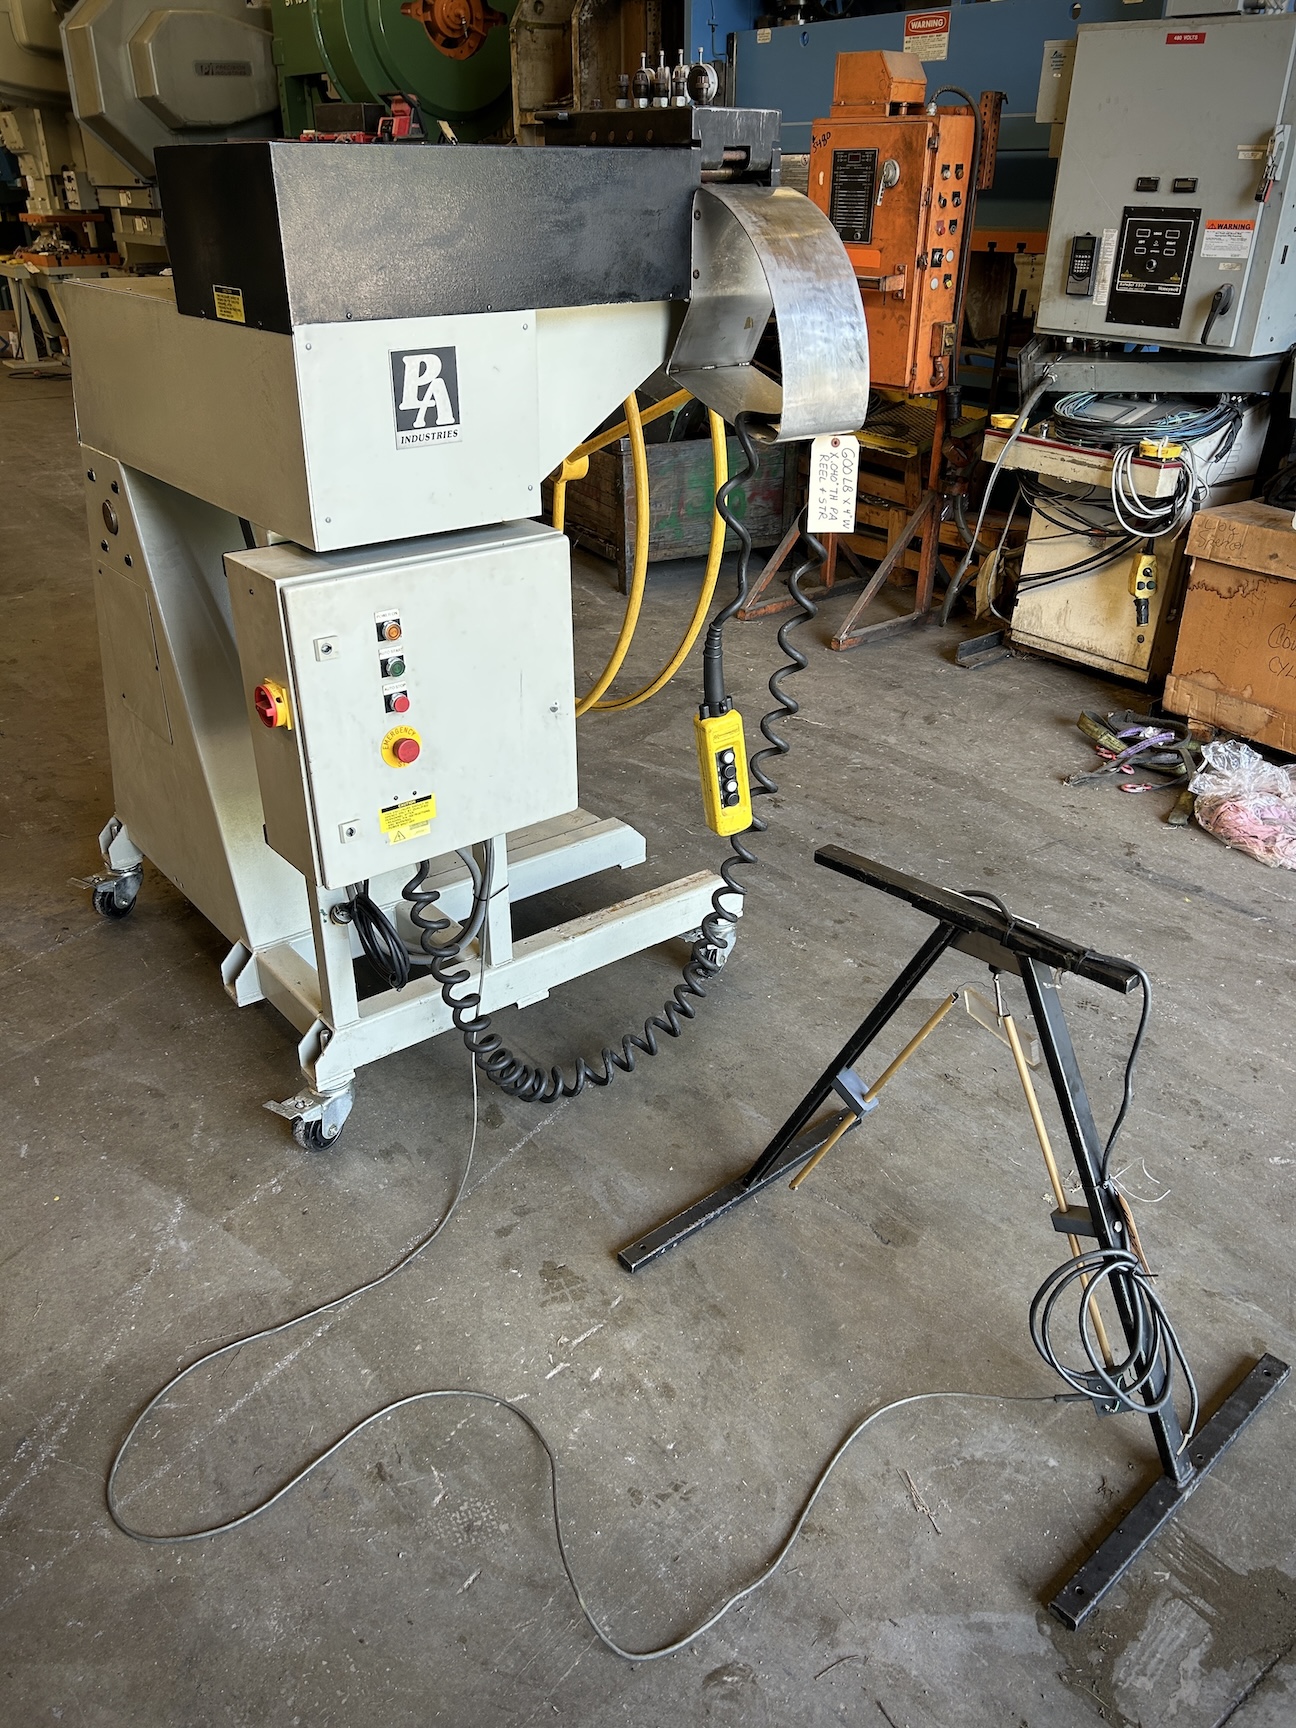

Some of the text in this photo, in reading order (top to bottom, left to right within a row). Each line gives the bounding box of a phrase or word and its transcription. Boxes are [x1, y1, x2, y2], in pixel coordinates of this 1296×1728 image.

[911, 19, 944, 30] WARNING
[401, 429, 459, 444] INDUSTRIES
[819, 454, 830, 483] REEL
[382, 726, 417, 750] EMERGENCY
